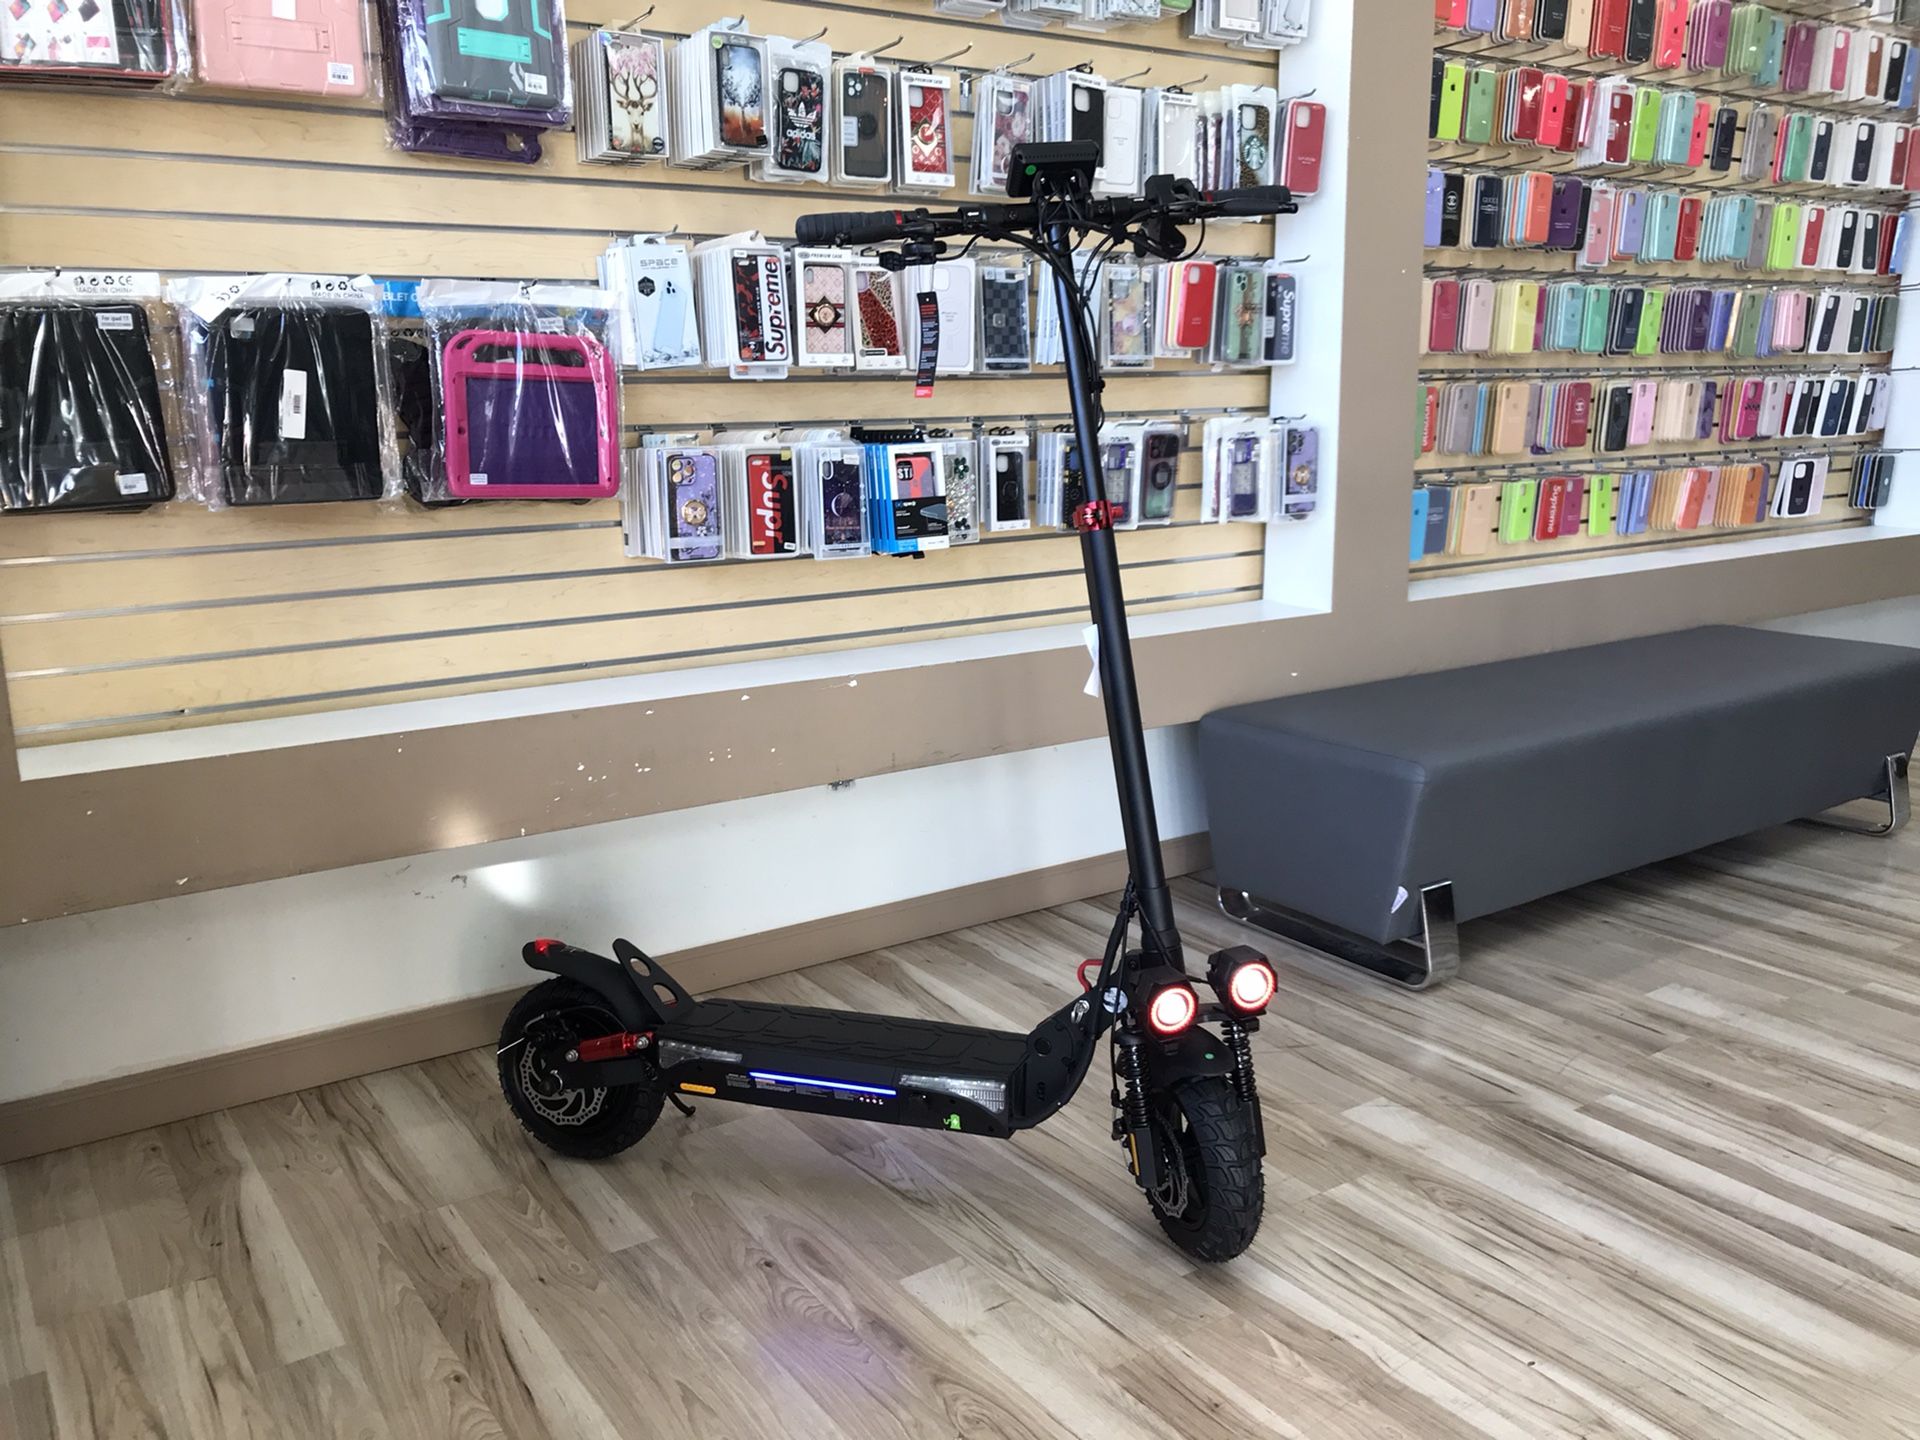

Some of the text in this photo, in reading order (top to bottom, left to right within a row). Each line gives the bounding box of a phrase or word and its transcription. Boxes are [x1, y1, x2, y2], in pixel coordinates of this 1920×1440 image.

[786, 128, 816, 140] adidas
[383, 292, 408, 301] BLET
[765, 256, 786, 356] Supreme
[1280, 289, 1296, 355] Supreme
[756, 471, 789, 544] Supr
[1547, 484, 1562, 533] Supreme
